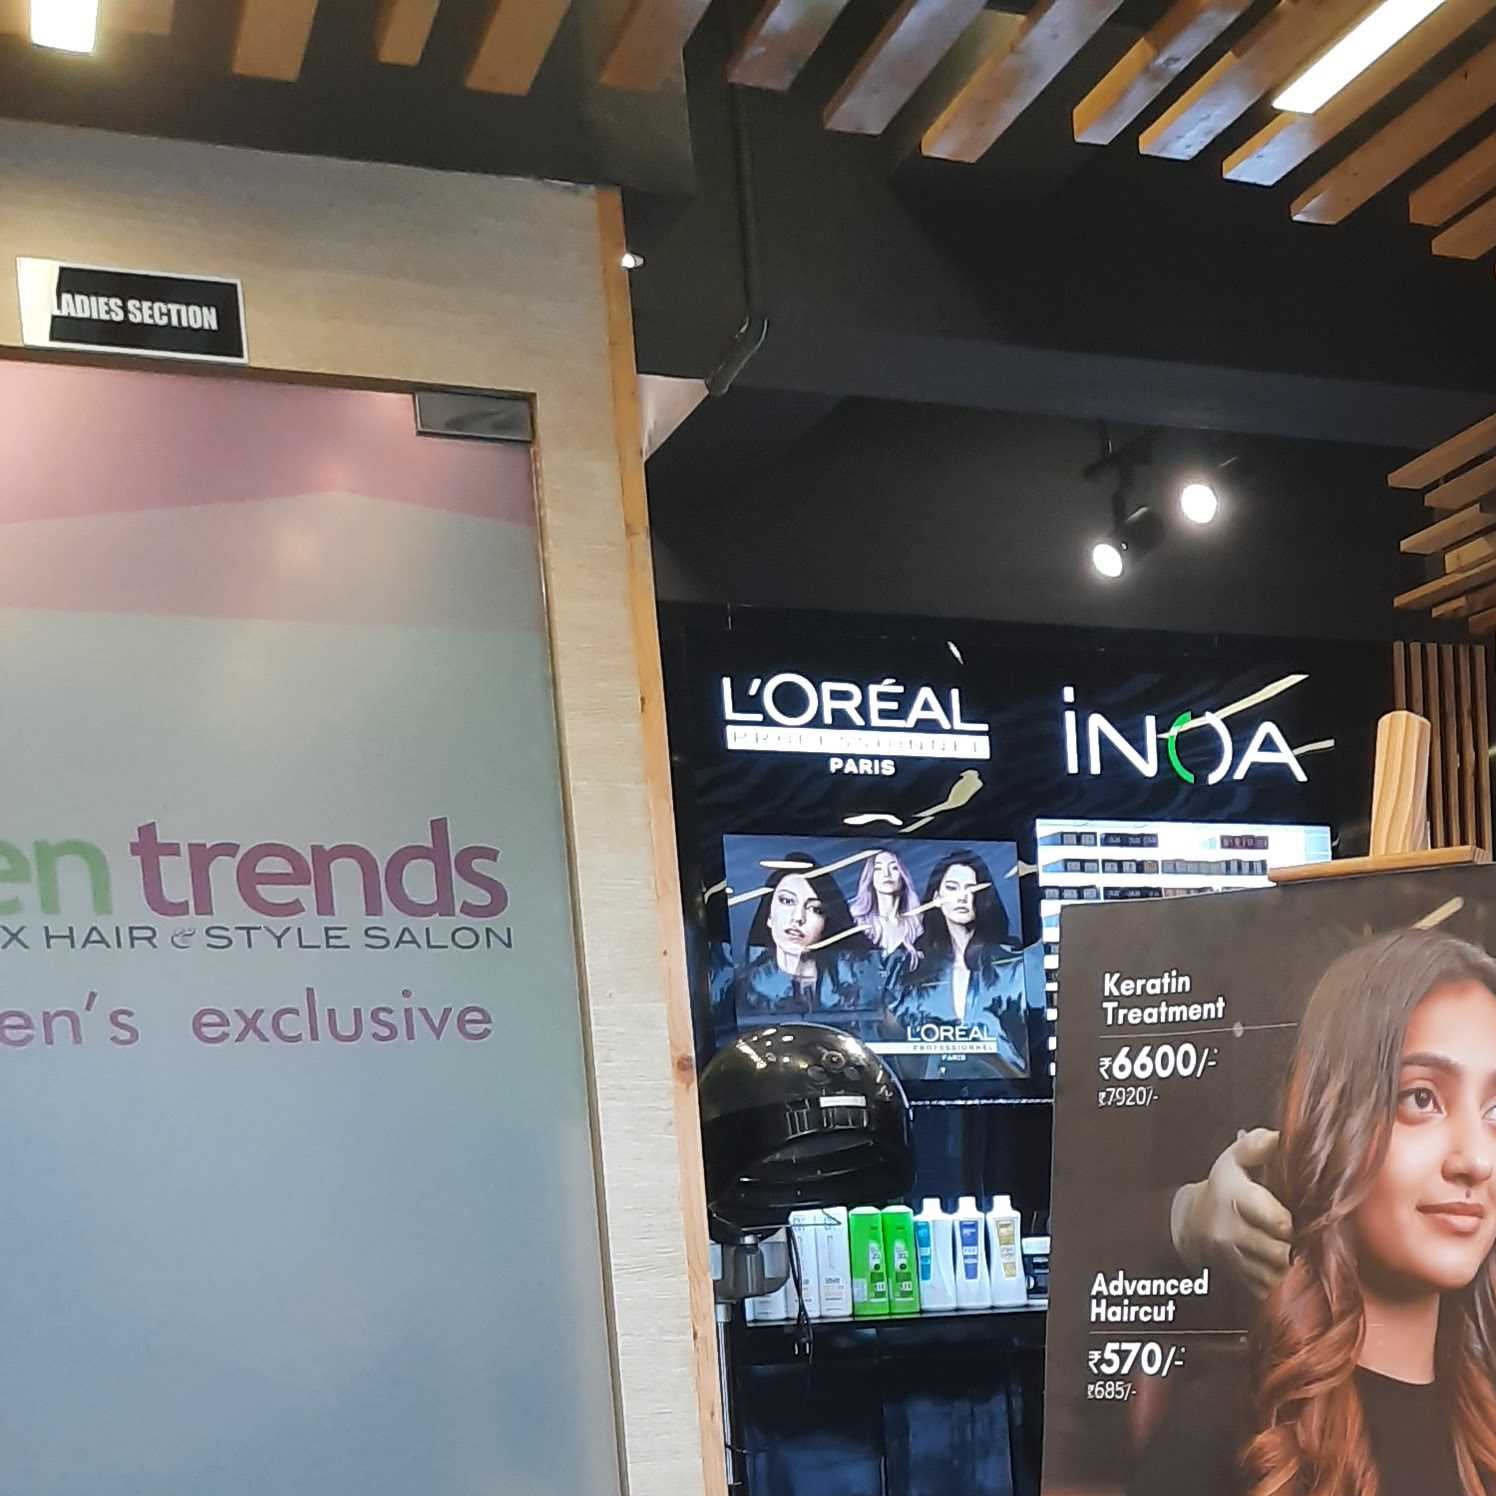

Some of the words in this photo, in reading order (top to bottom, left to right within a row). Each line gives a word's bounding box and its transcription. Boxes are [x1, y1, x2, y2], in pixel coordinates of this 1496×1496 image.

[127, 299, 219, 330] SECTION
[722, 672, 989, 731] L'ORÉAL
[830, 757, 896, 776] PARIS
[130, 817, 509, 919] trends
[44, 926, 158, 949] HAIR
[171, 928, 196, 949] &
[205, 926, 350, 949] STYLE
[364, 926, 513, 949] SALON
[1103, 970, 1191, 996] Keratin
[192, 987, 493, 1043] exclusive
[1102, 996, 1226, 1025] Treatment
[1090, 1268, 1209, 1296] Advanced
[1090, 1298, 1176, 1322] Haircut
